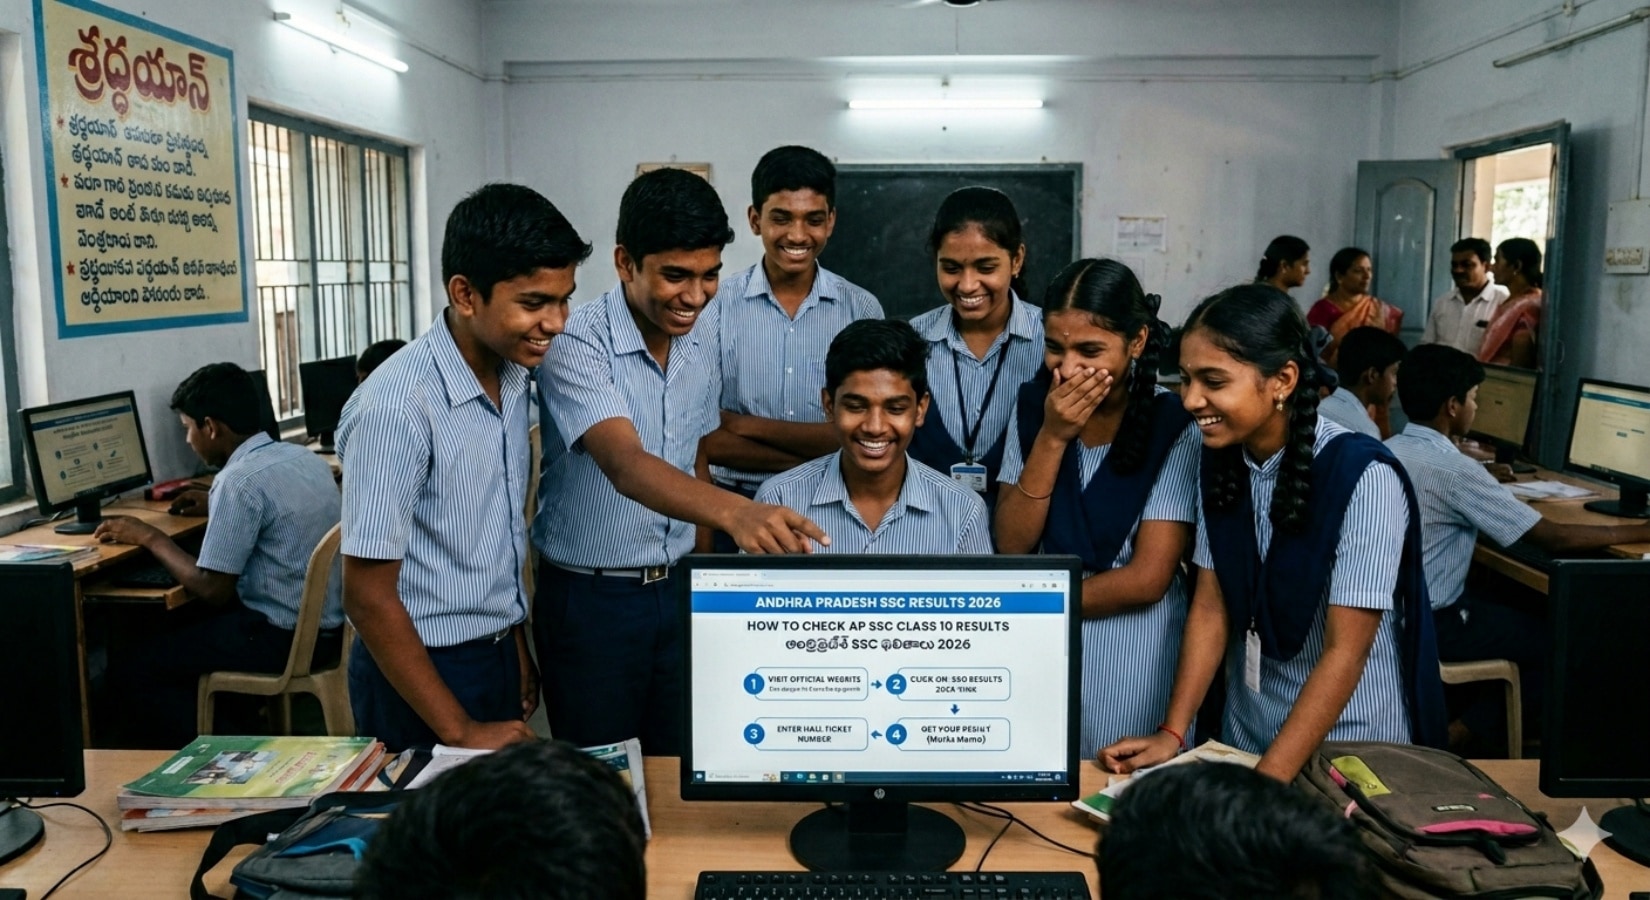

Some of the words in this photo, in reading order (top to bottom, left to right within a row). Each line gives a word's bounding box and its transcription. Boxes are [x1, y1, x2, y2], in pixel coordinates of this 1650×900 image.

[756, 597, 812, 608] ANDHRA
[816, 597, 877, 608] PRADESH
[880, 597, 906, 608] SSC
[909, 597, 966, 608] RESULTS
[968, 597, 1001, 608] 2026
[747, 621, 779, 631] HOW
[782, 621, 799, 631] TO
[802, 621, 845, 631] CHECK
[849, 621, 866, 631] AP
[869, 621, 893, 631] SSC
[896, 621, 937, 631] CLASS
[940, 621, 953, 631] 10
[956, 621, 1010, 631] RESULTS
[851, 639, 878, 649] SSC
[938, 639, 971, 649] 2026
[751, 678, 757, 690] 1
[892, 679, 901, 690] 2
[750, 729, 758, 739] 3
[892, 729, 901, 740] 4
